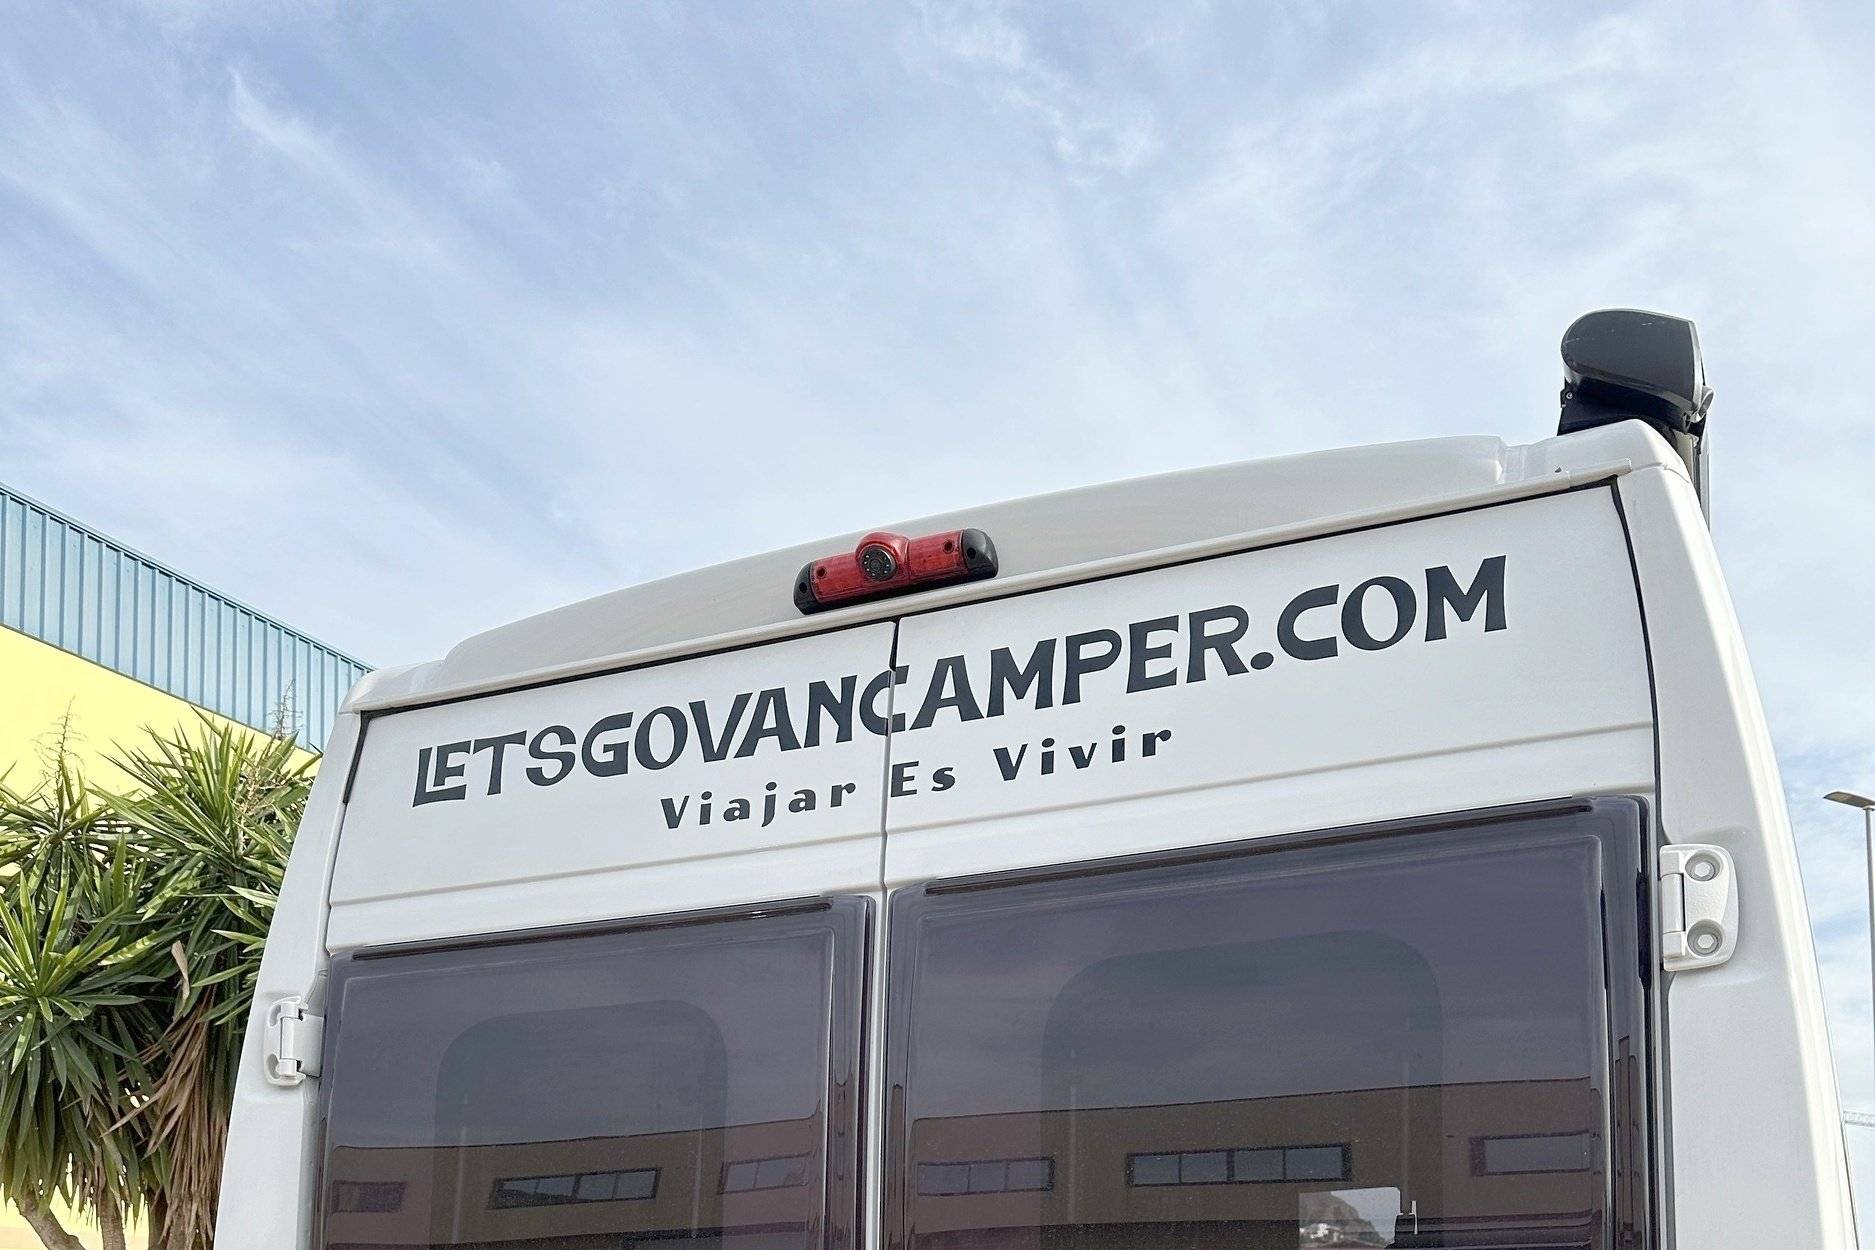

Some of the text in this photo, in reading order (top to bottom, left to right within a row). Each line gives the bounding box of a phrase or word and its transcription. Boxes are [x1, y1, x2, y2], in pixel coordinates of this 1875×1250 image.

[412, 555, 1508, 808] LETSGOVANCAMPER.COM
[660, 724, 1173, 829] Viajar Es Vivir
